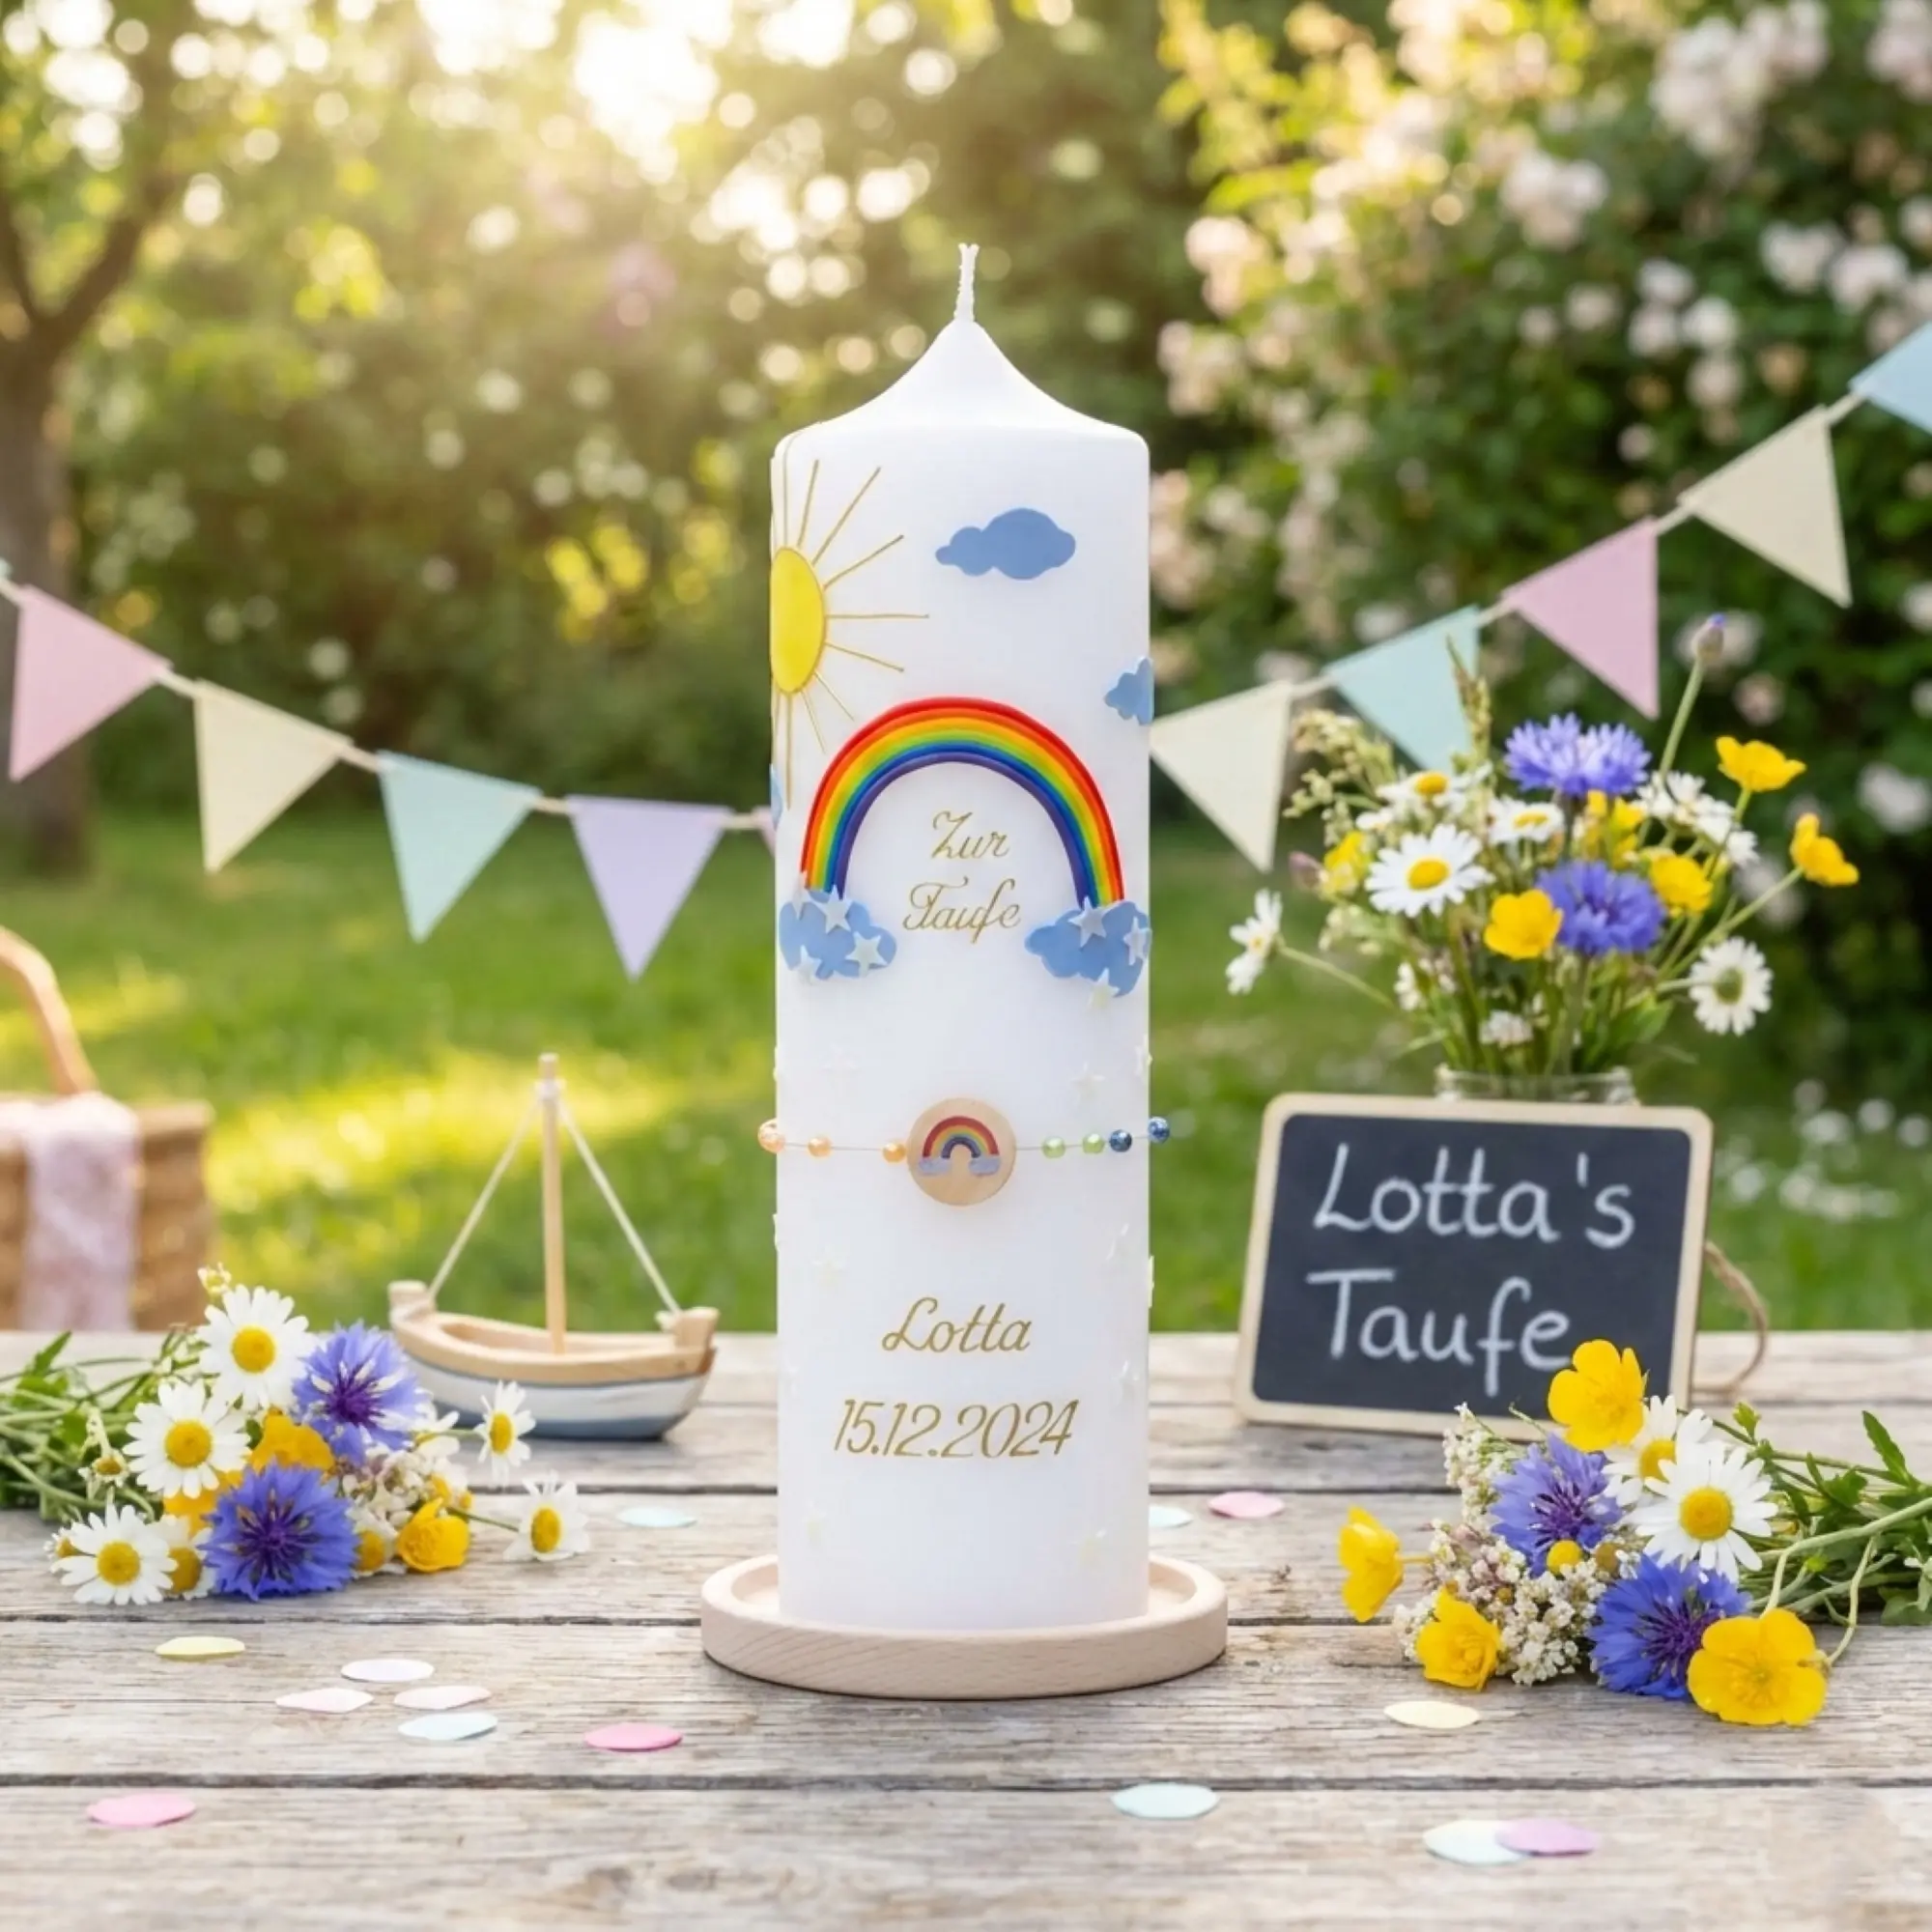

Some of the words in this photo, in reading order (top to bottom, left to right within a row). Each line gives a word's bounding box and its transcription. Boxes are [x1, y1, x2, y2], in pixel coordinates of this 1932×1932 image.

[930, 810, 1010, 860] Zur
[902, 875, 1022, 944] Taufe
[1313, 1143, 1635, 1248] Lotta's
[881, 1296, 1032, 1353] Lotta
[1306, 1267, 1571, 1398] Taufe
[834, 1399, 1080, 1459] 15.12.2024
